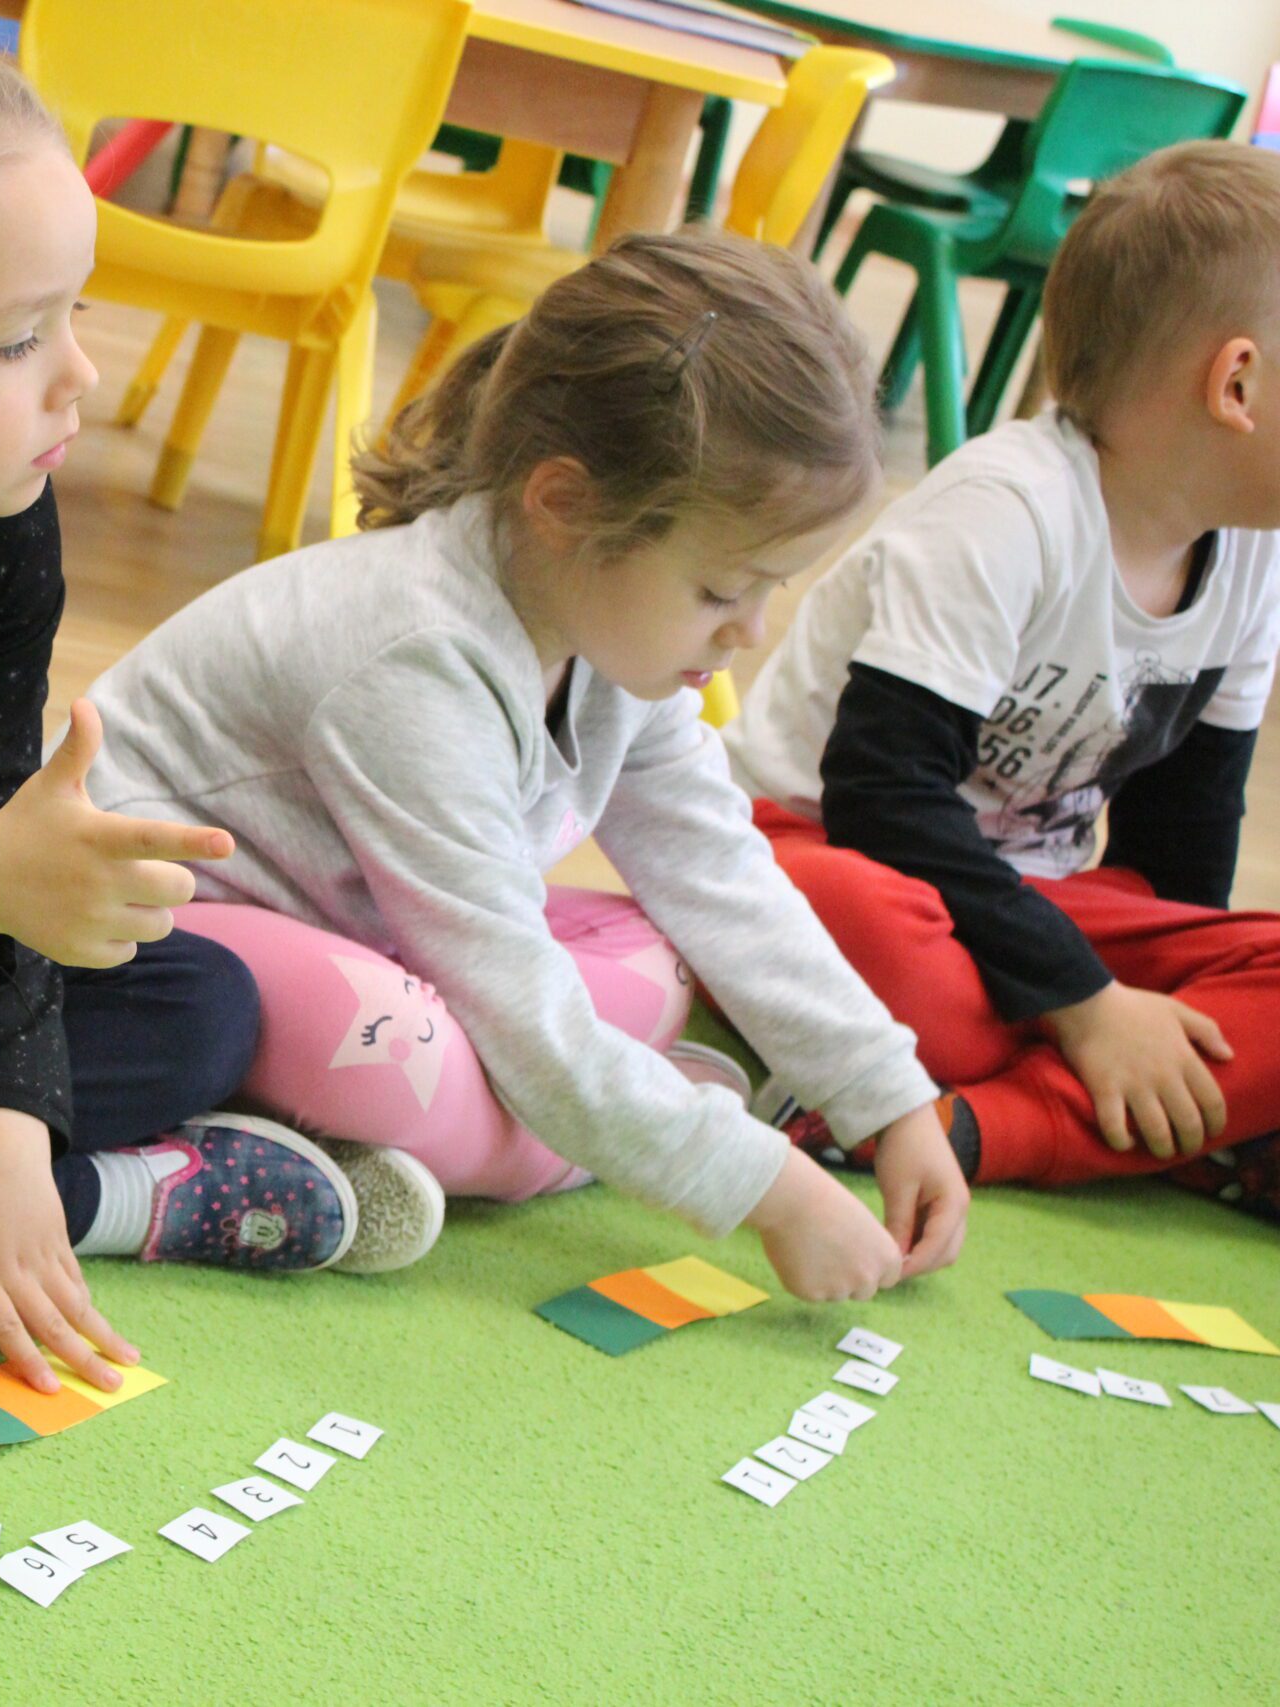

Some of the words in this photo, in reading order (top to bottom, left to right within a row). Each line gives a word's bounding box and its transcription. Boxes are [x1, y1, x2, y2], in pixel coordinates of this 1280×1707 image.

[977, 733, 1032, 779] 56
[329, 1421, 362, 1438] 1
[802, 1422, 832, 1440] 3
[277, 1451, 312, 1471] 2
[776, 1446, 807, 1465] 2
[742, 1470, 773, 1489] 1
[241, 1484, 274, 1504] 3
[187, 1521, 219, 1542] 4
[65, 1532, 99, 1554] 5
[22, 1556, 56, 1579] 6
